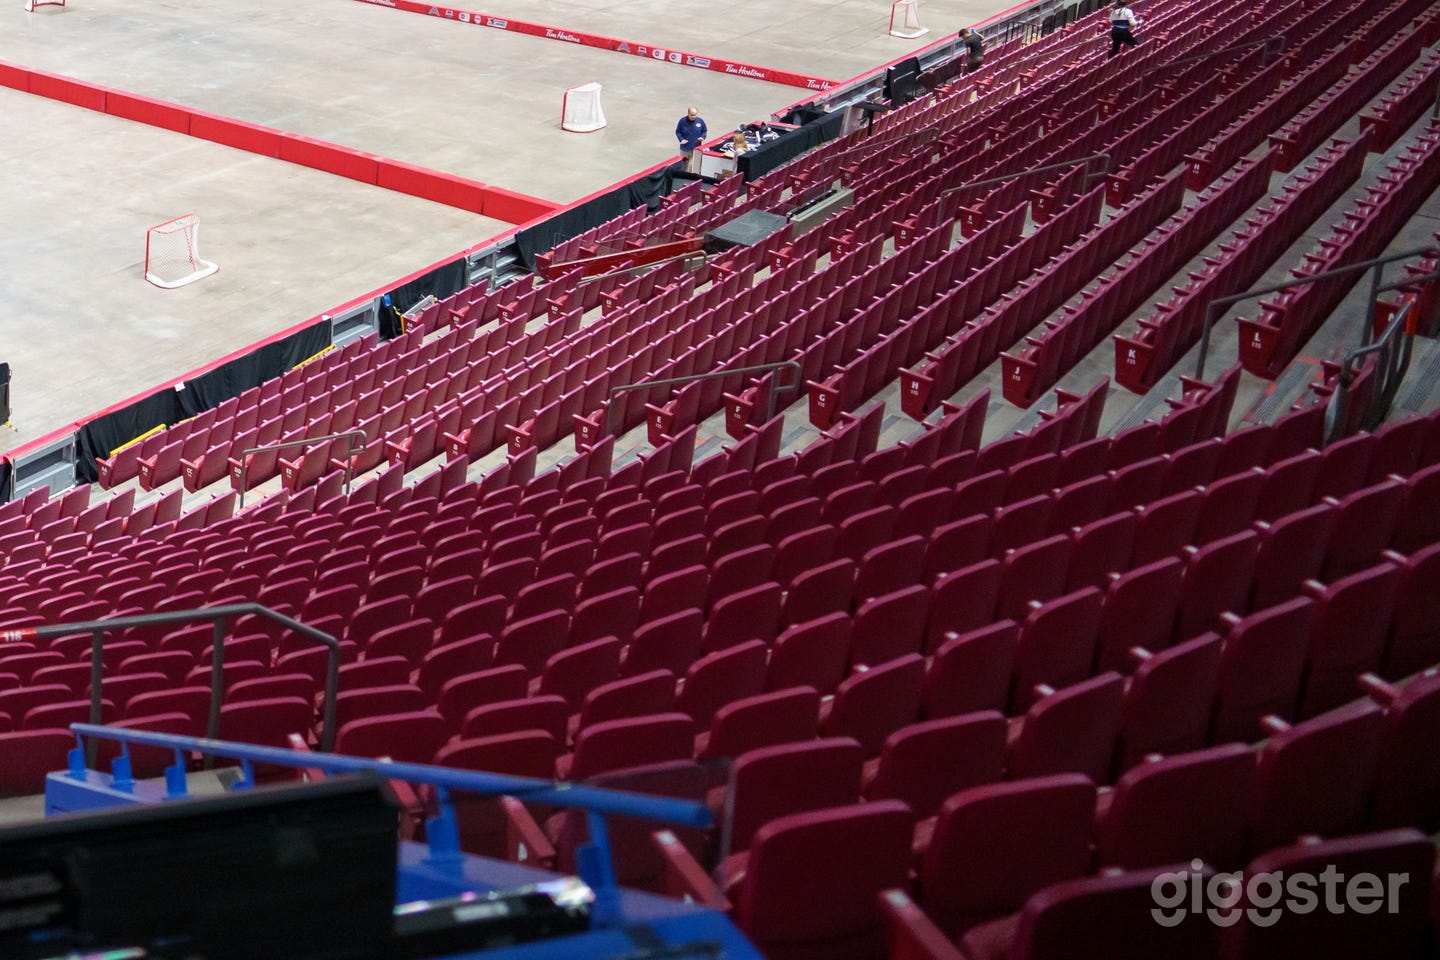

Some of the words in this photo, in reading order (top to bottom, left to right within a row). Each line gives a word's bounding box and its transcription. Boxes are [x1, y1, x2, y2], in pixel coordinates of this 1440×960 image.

[557, 31, 580, 42] Hortons
[726, 64, 738, 73] Tim
[738, 67, 765, 78] Hortons
[807, 80, 820, 90] Tim
[1254, 332, 1260, 342] L
[1128, 349, 1136, 358] K
[912, 381, 919, 389] H
[4, 631, 21, 641] 116
